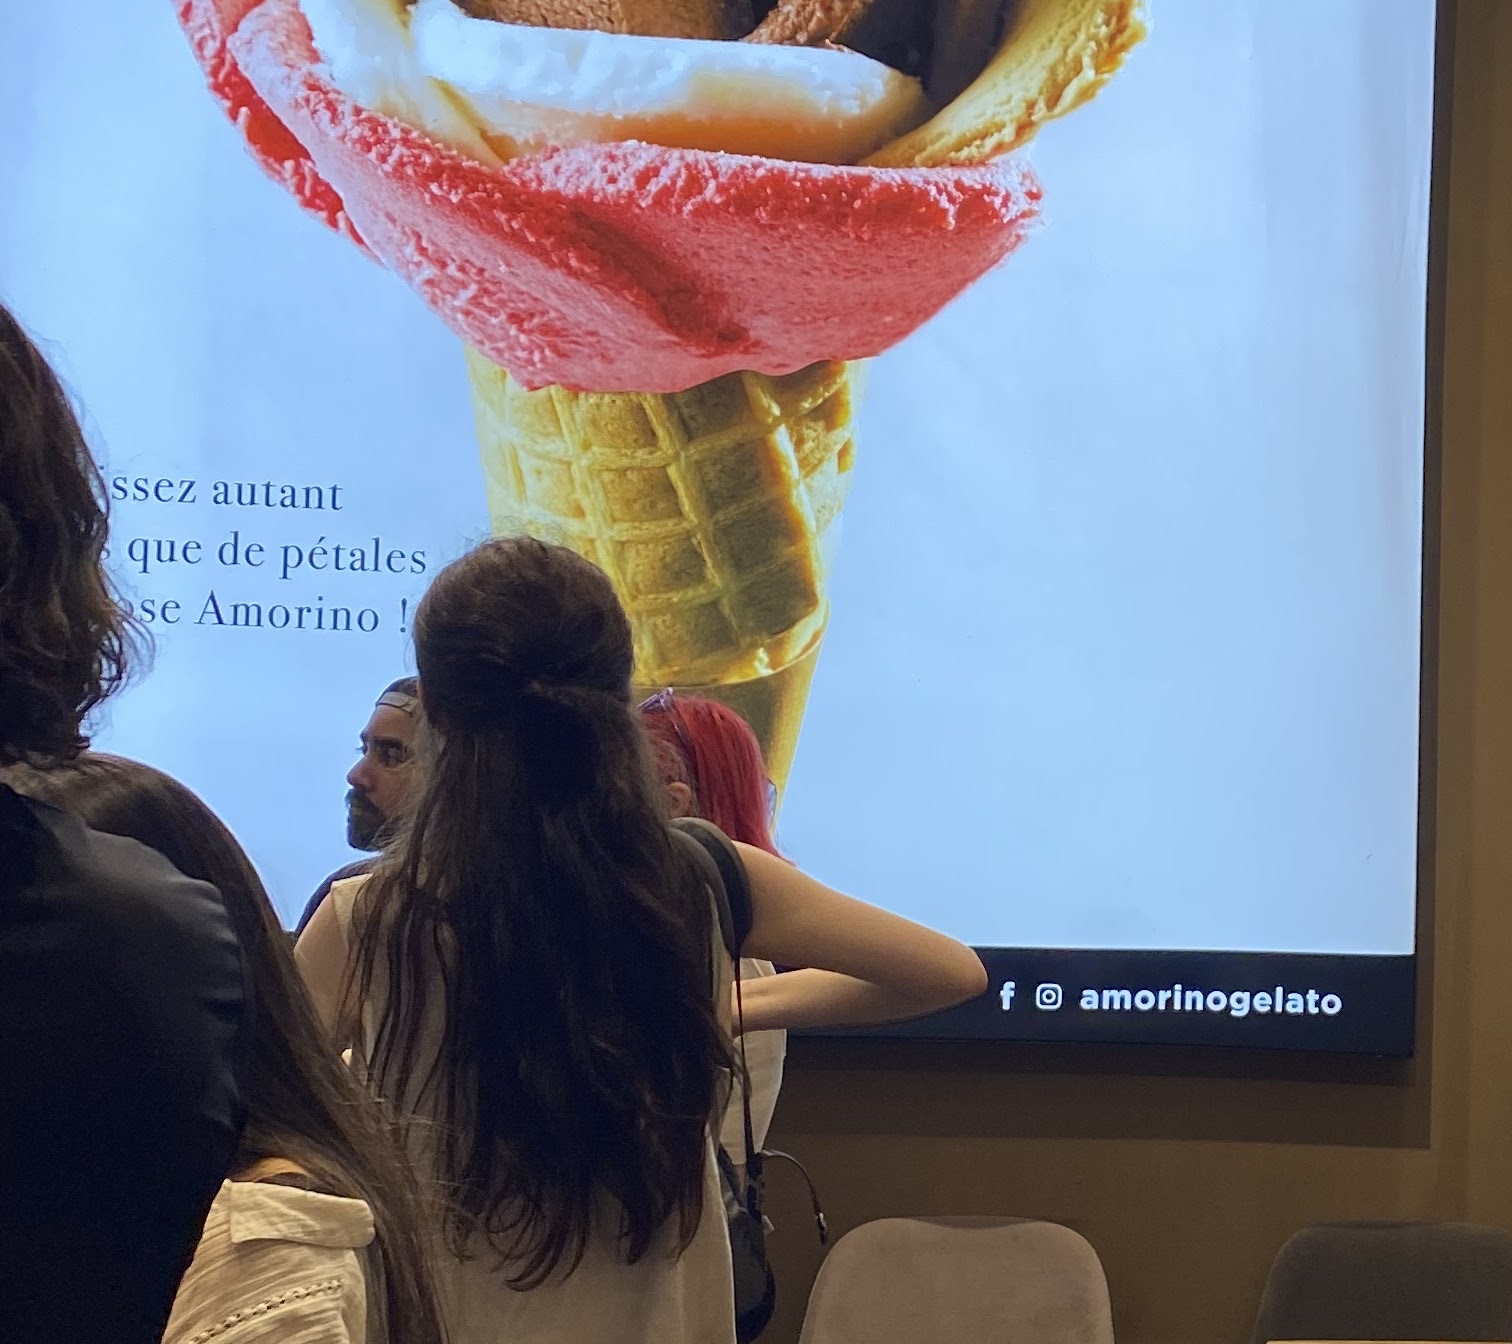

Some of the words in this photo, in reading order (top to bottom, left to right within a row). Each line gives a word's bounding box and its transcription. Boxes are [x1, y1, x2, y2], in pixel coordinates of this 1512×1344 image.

[100, 466, 197, 504] ssez
[212, 480, 344, 511] autant
[127, 536, 202, 575] que
[218, 531, 265, 567] de
[278, 536, 427, 580] pétales
[194, 589, 379, 632] Amorino
[1080, 983, 1343, 1017] amorinogelato
